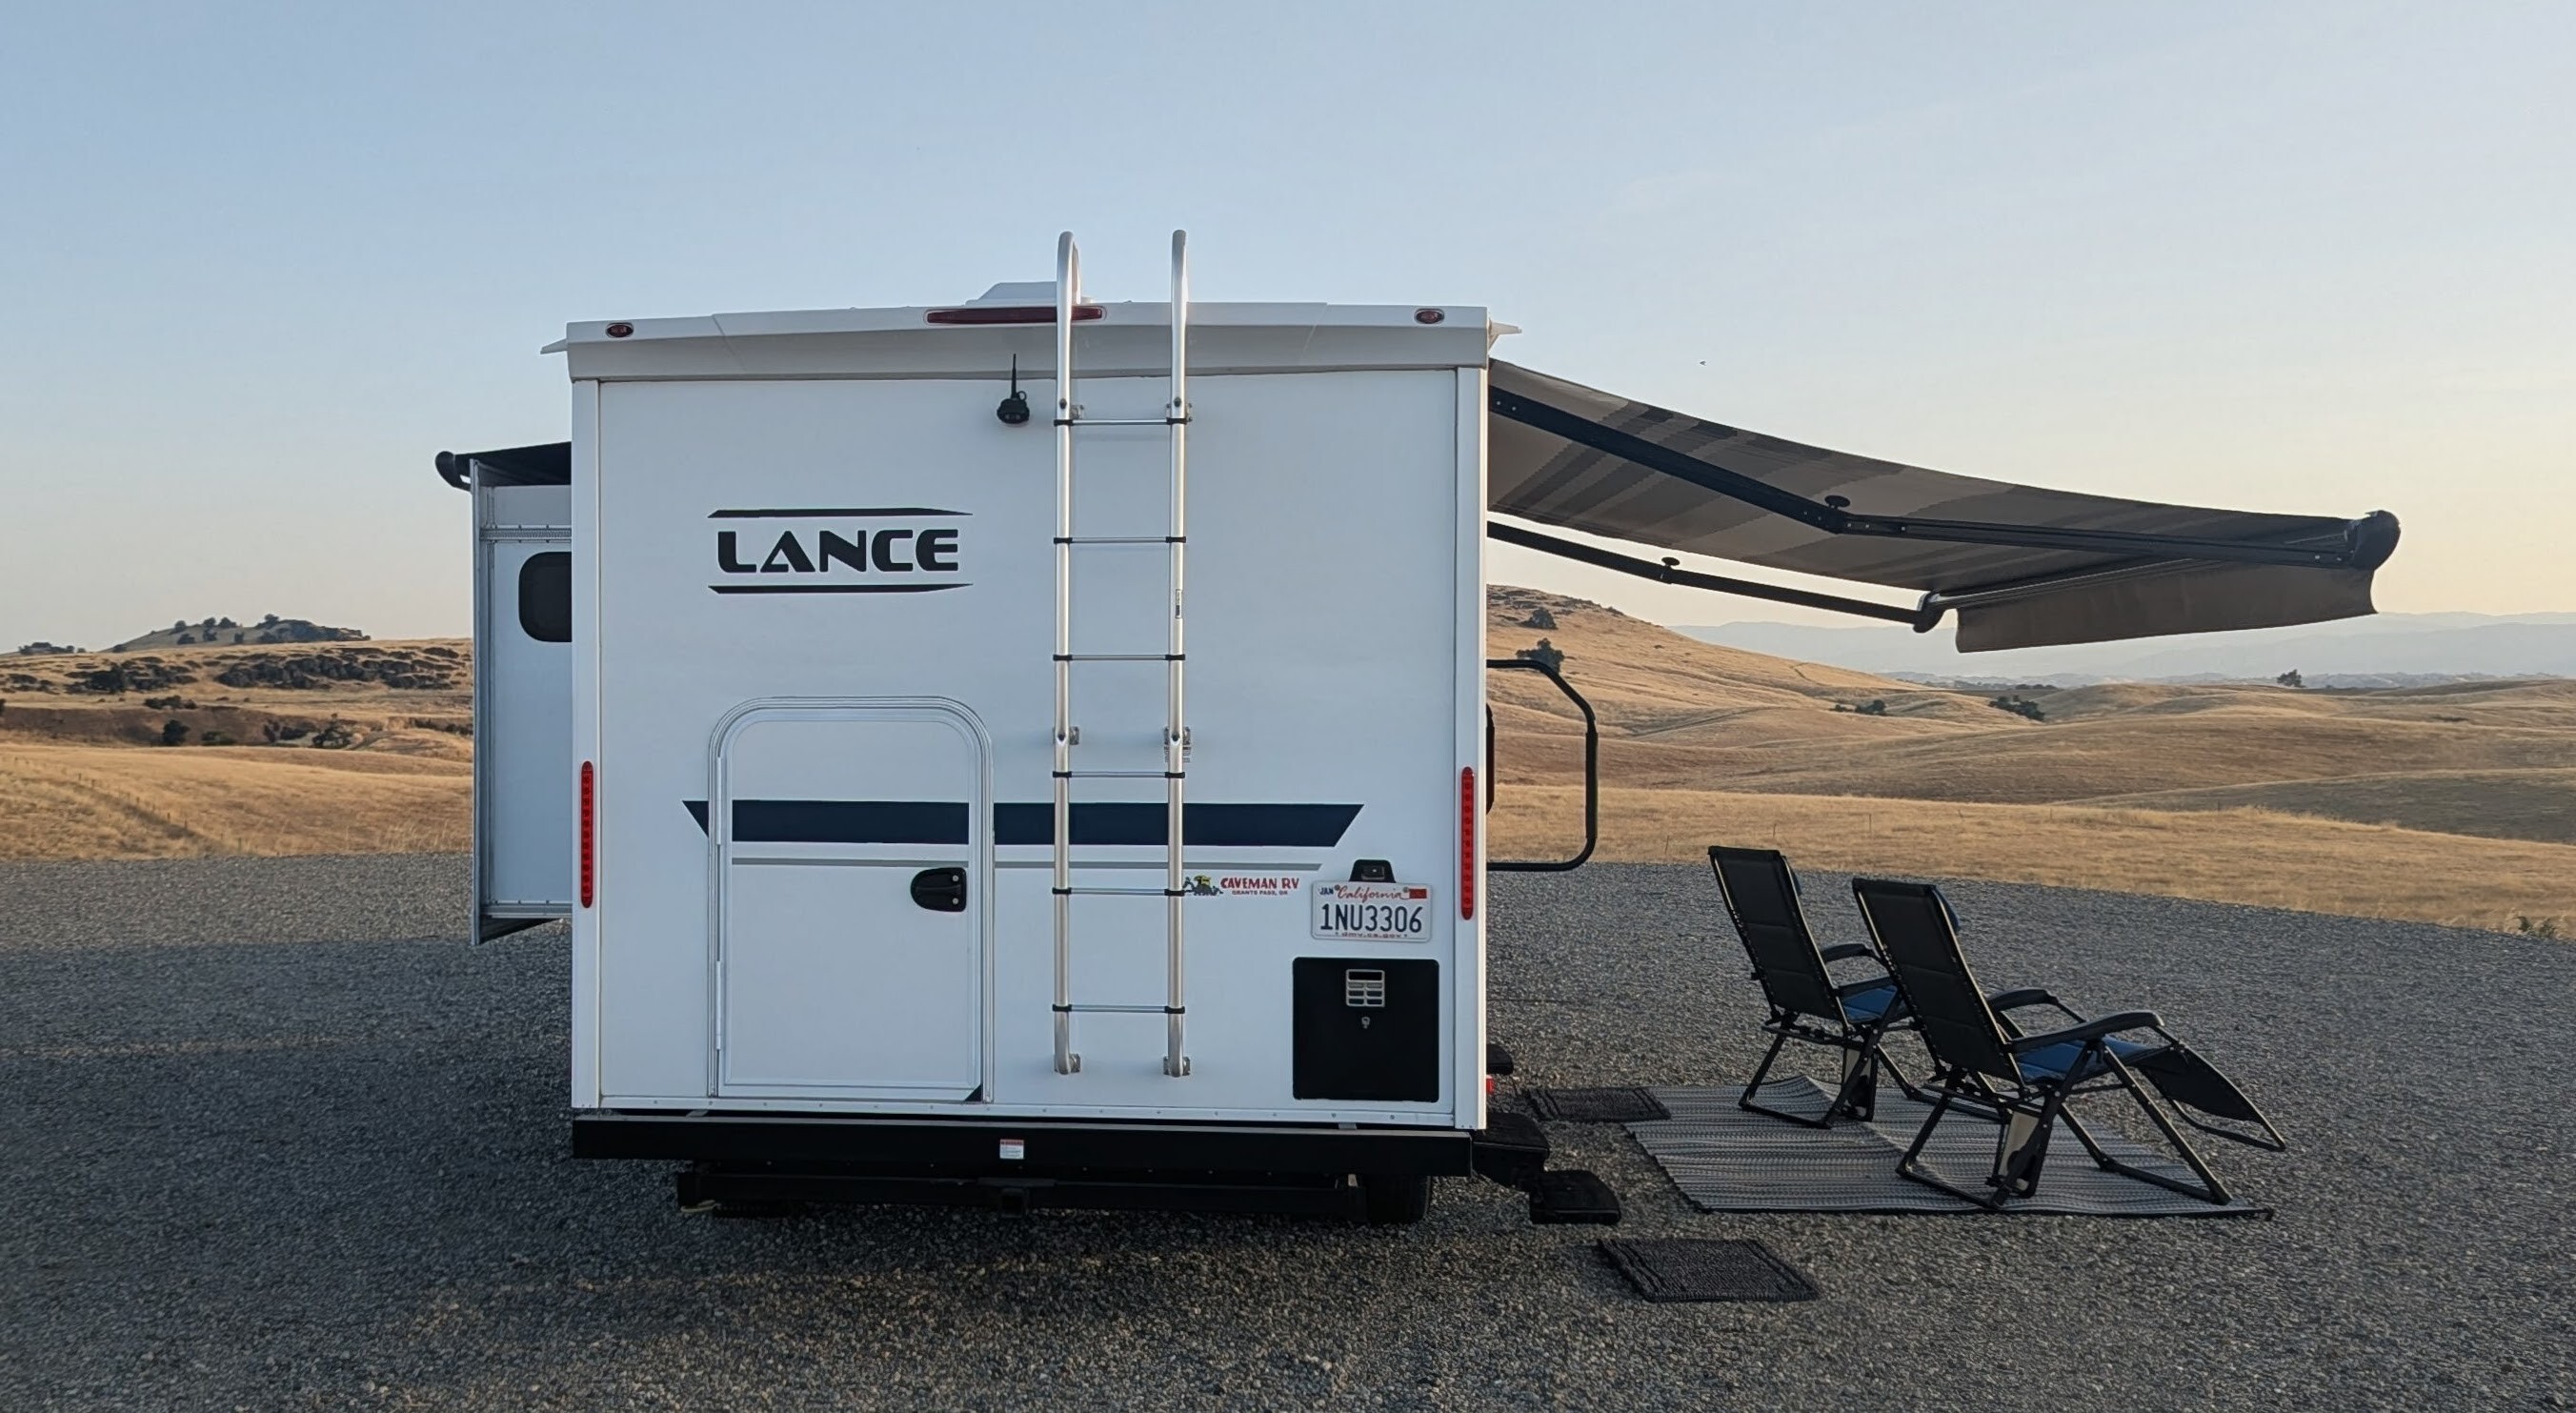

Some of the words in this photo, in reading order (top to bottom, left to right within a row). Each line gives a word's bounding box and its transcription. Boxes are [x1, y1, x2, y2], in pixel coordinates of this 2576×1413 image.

[717, 529, 958, 574] LANCE
[1220, 877, 1278, 889] CAVEMAN
[1281, 878, 1299, 889] RV
[1319, 887, 1334, 896] JAN
[1337, 885, 1409, 903] California
[1320, 903, 1423, 933] 1NU3306
